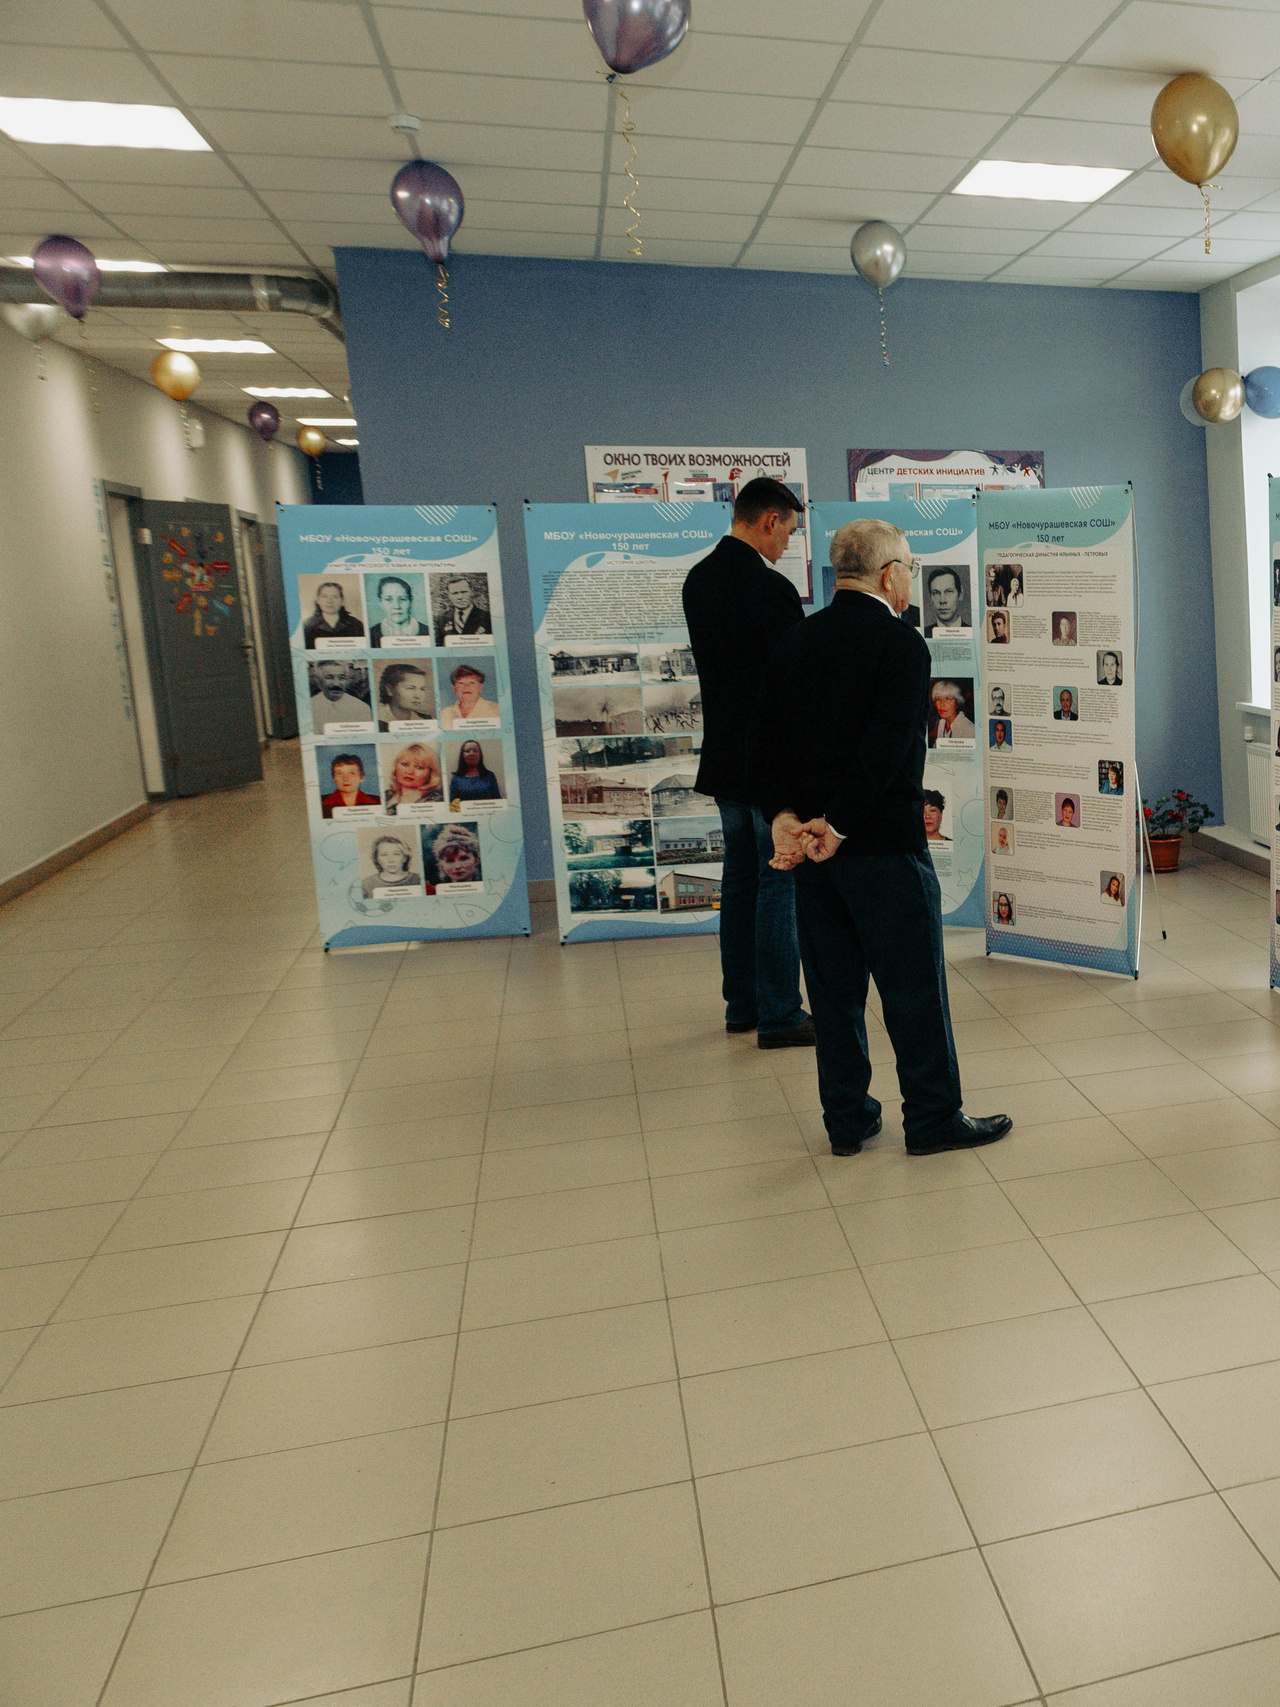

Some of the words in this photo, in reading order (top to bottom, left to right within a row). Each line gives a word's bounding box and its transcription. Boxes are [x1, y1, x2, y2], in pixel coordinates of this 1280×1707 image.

[604, 454, 640, 466] ОКНО
[644, 454, 686, 466] ТВОИХ
[689, 452, 790, 467] ВОЗМОЖНОСТЕЙ
[897, 468, 934, 476] ДЕТСКИХ
[936, 468, 985, 476] ИНИЦИАТИВ
[988, 522, 1010, 530] МБОУ
[1012, 520, 1088, 530] «Новочурашевская
[1090, 518, 1116, 528] СОШ»
[544, 532, 576, 540] МБОУ
[579, 531, 679, 541] «Новочурашевская
[682, 530, 714, 538] СОШ»
[936, 528, 963, 536] СОШ»
[300, 534, 332, 542] МБОУ
[334, 534, 442, 544] «Новочурашевская
[444, 534, 478, 542] СОШ»
[1036, 534, 1050, 542] 150
[612, 542, 629, 550] 150
[372, 548, 389, 556] 150
